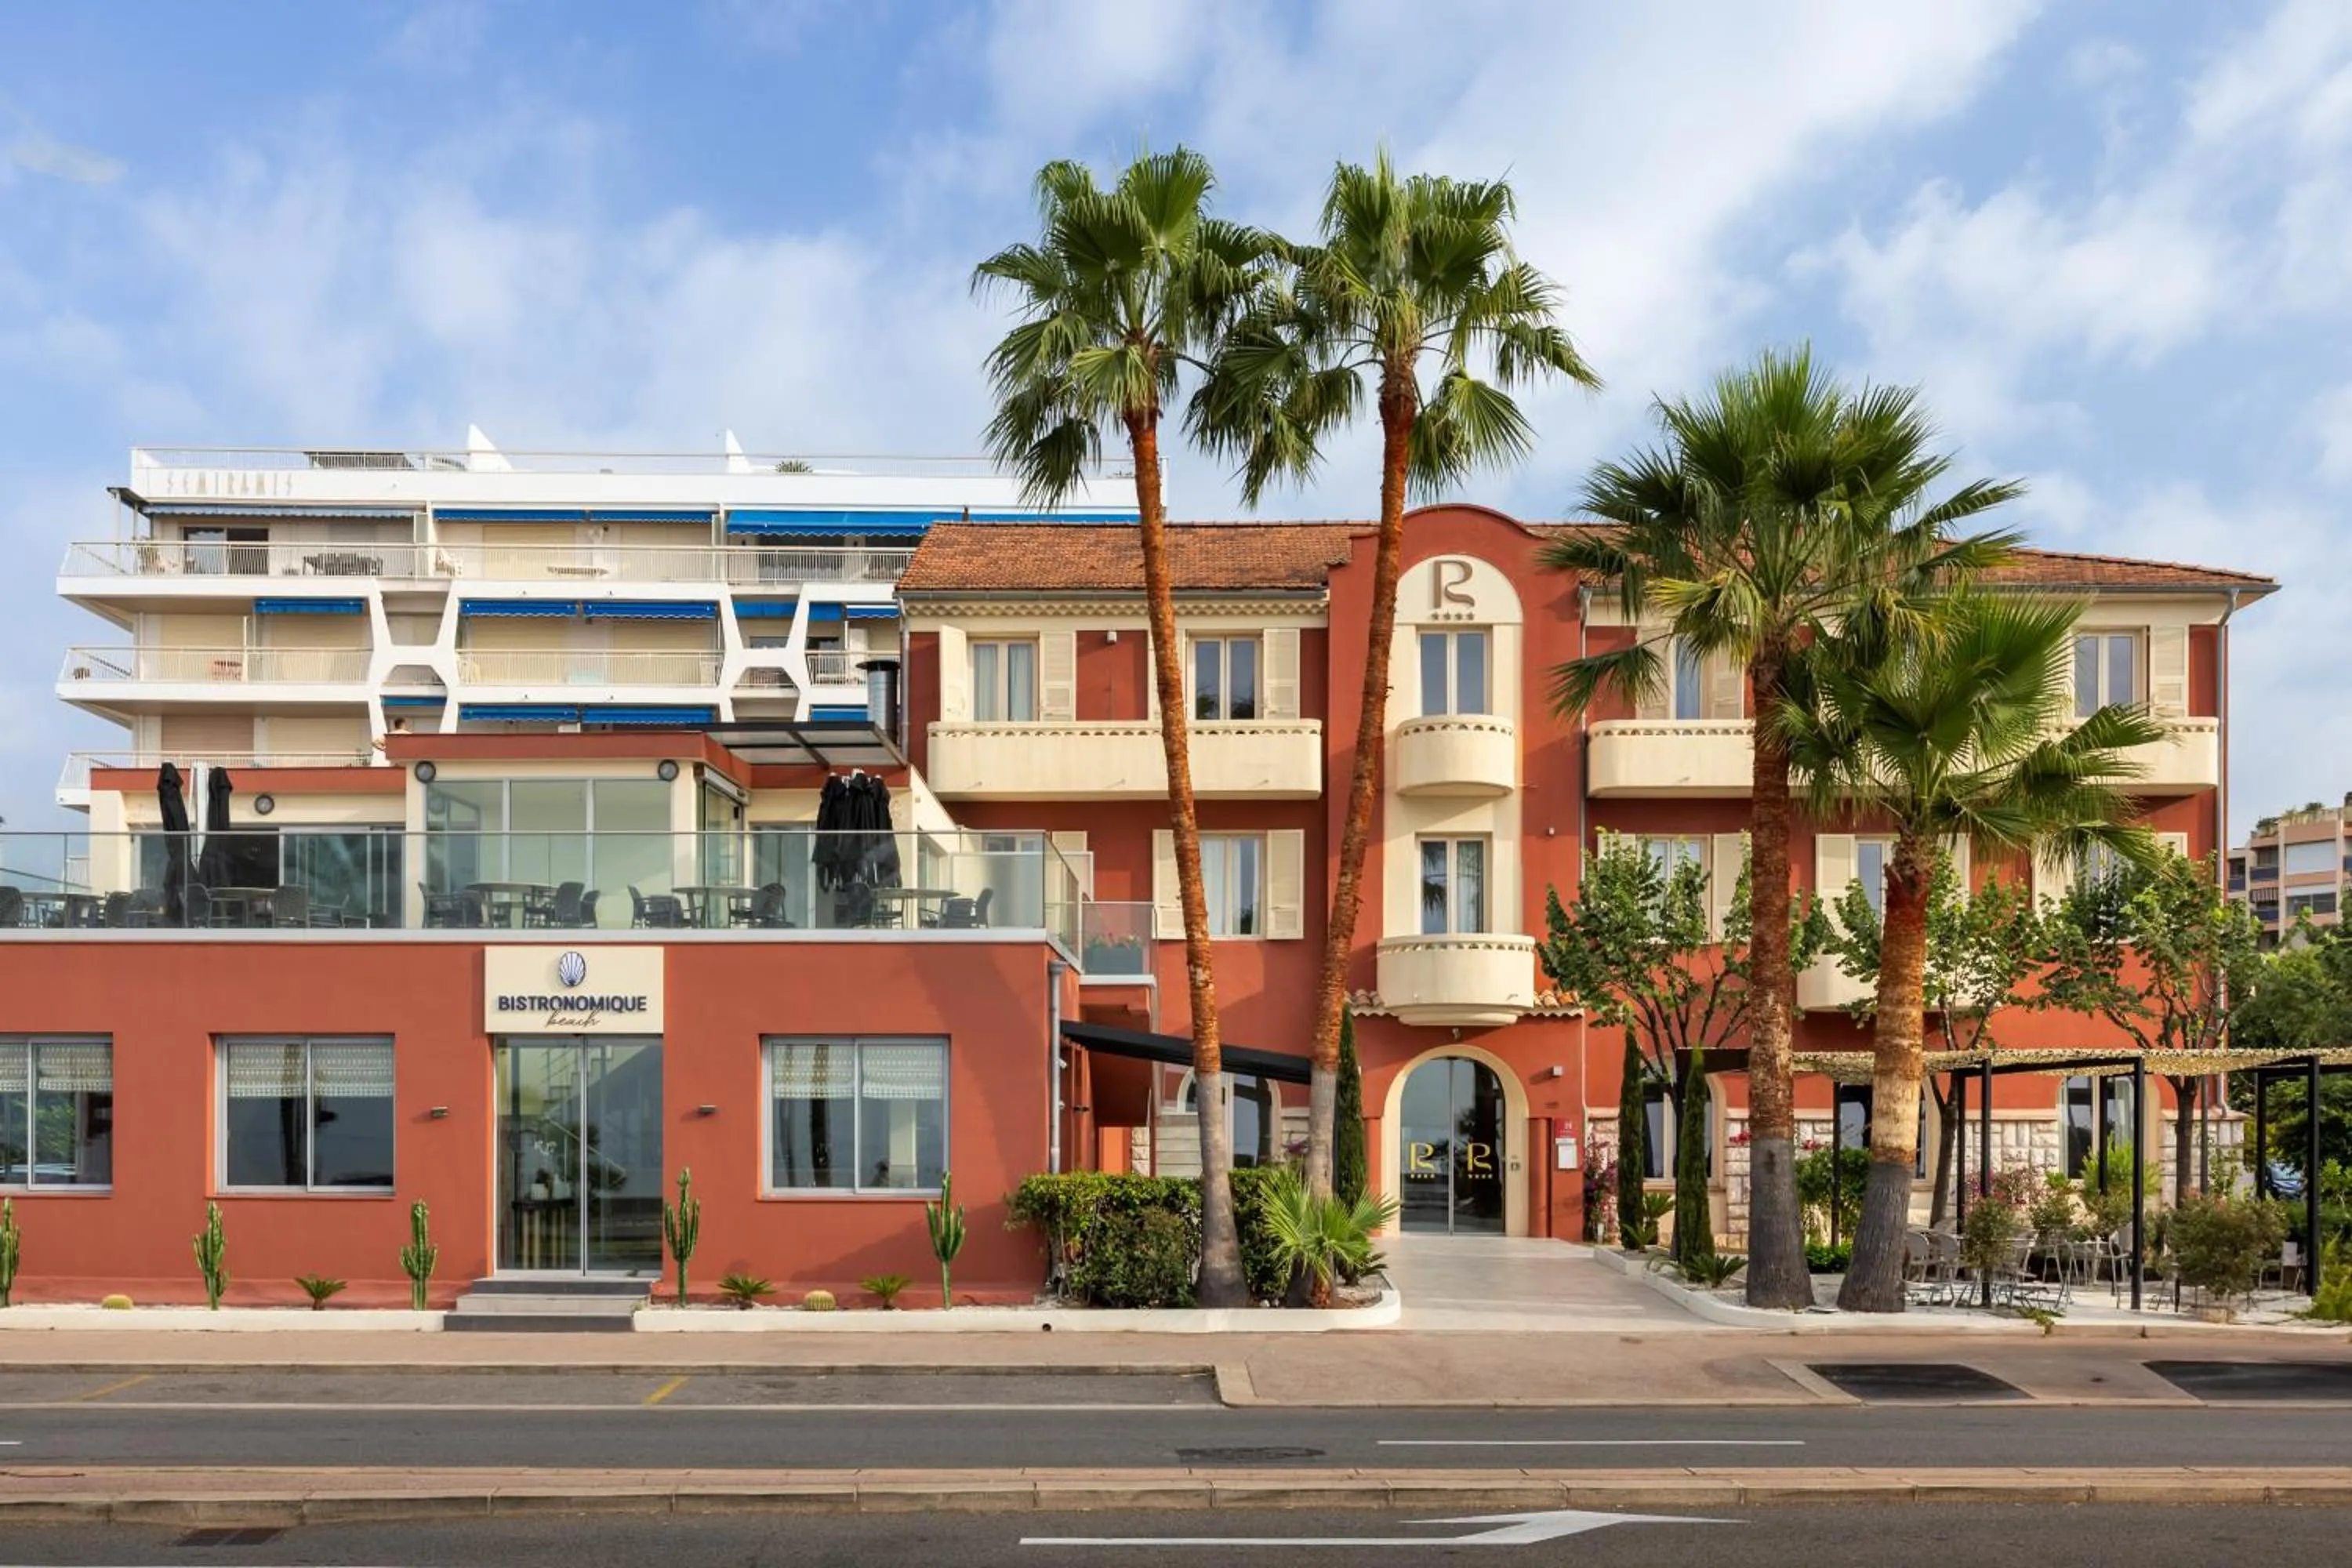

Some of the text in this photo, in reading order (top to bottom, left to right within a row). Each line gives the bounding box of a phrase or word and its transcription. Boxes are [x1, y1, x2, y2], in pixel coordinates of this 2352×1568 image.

[1432, 560, 1475, 609] R
[498, 995, 647, 1013] BISTRONOMIQUE
[545, 1009, 601, 1028] beach
[1410, 1142, 1434, 1171] R
[1468, 1142, 1492, 1171] R
